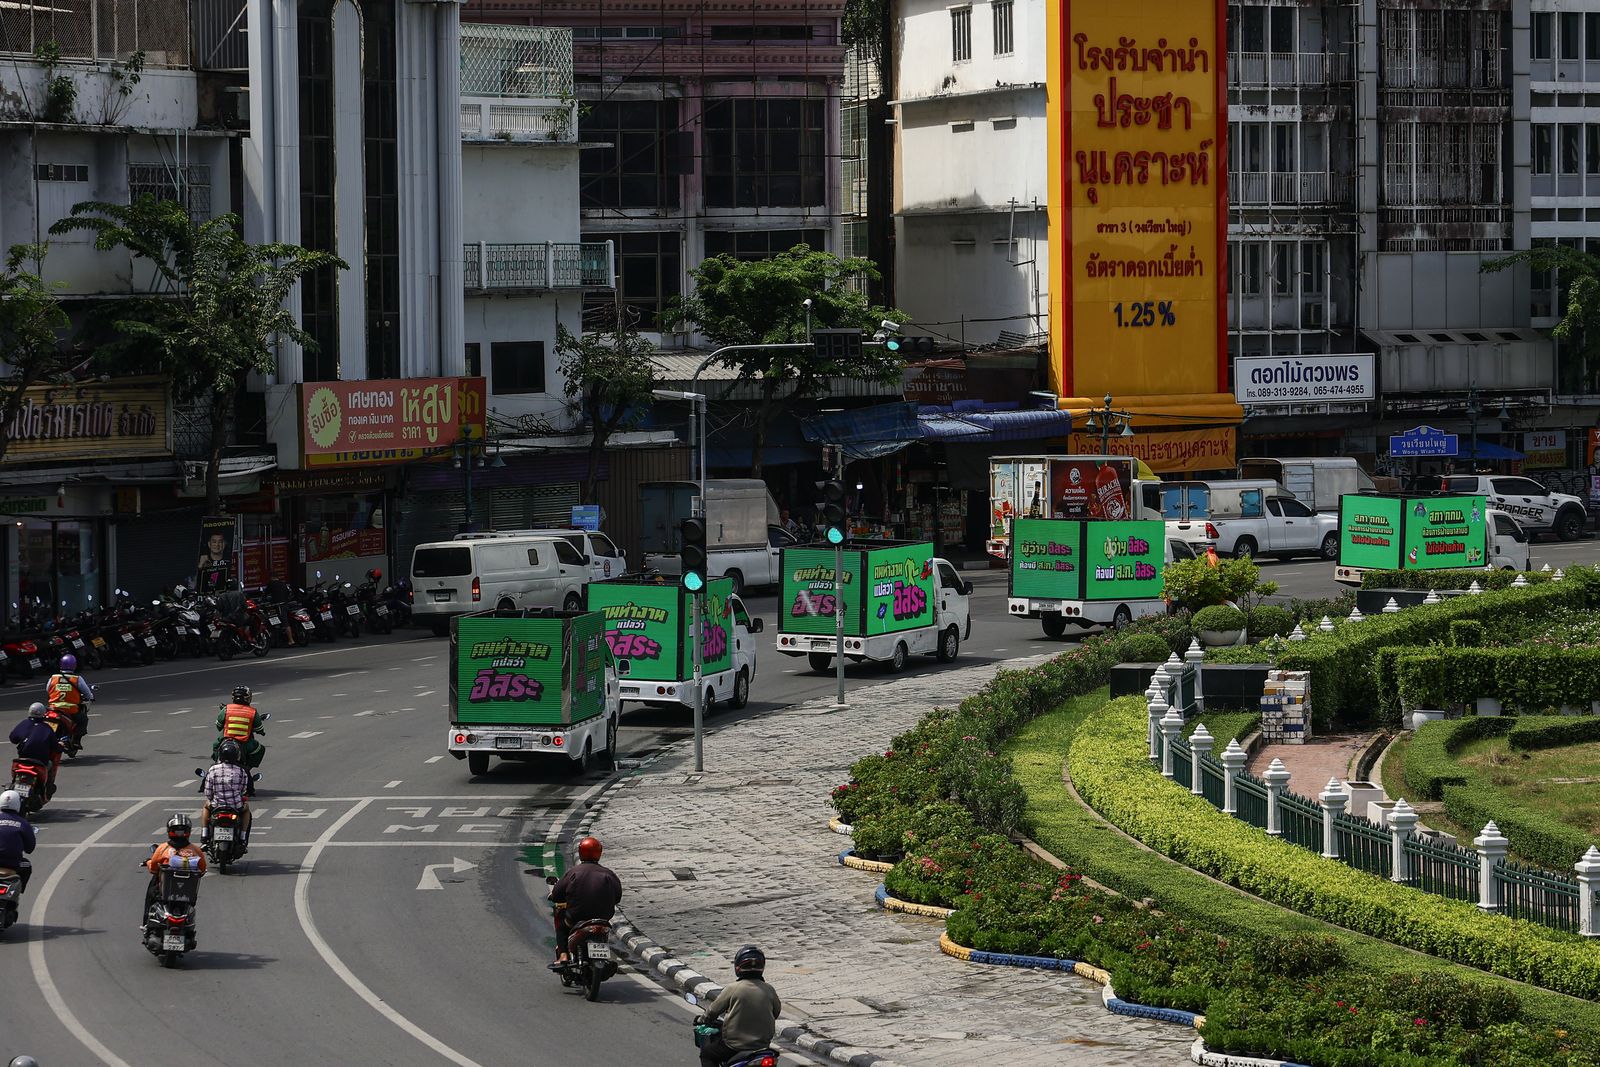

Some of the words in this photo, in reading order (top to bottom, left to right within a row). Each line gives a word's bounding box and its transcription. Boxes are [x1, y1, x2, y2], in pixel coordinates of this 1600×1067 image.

[1073, 32, 1209, 73] โรงรับจำนำ
[1093, 76, 1192, 131] ประชา
[1075, 138, 1214, 205] นุเคราะห์
[1096, 221, 1119, 234] สาขา
[1119, 222, 1127, 234] 3
[1085, 244, 1204, 278] อัตราดอกเบี้ยต่ำ
[1113, 301, 1176, 328] 1.25%
[1251, 360, 1360, 384] ดอกไม้ดวงพร
[311, 395, 338, 434] รับซื้อ
[348, 391, 394, 409] เศษทอง
[400, 388, 420, 423] ให้
[422, 383, 453, 443] สูง
[380, 414, 394, 424] นาค
[402, 426, 422, 440] ราคา
[1532, 434, 1556, 447] ขาย
[1401, 437, 1447, 449] วงเวียนใหญ่
[1354, 514, 1368, 522] สภา
[1429, 511, 1444, 522] สภา
[1445, 510, 1464, 522] กทม.
[1496, 503, 1544, 518] RANGER
[1021, 541, 1047, 557] ผู้ว่าฯ
[1048, 542, 1072, 555] อิสระ
[1103, 536, 1127, 560] ผู้ว่าฯ
[1128, 536, 1149, 555] อิสระ
[874, 561, 903, 580] คนทำงาน
[1055, 560, 1074, 571] อิสระ
[1095, 565, 1114, 580] ต้องมี
[1135, 561, 1156, 580] อิสระ
[808, 580, 834, 590] แปลว่า
[873, 580, 894, 597] แปลว่า
[893, 580, 927, 618] อิสระ
[616, 619, 646, 630] แปลว่า
[470, 636, 551, 660] คนทำงาน
[491, 657, 526, 668] แปลว่า
[469, 668, 544, 703] อิสระ
